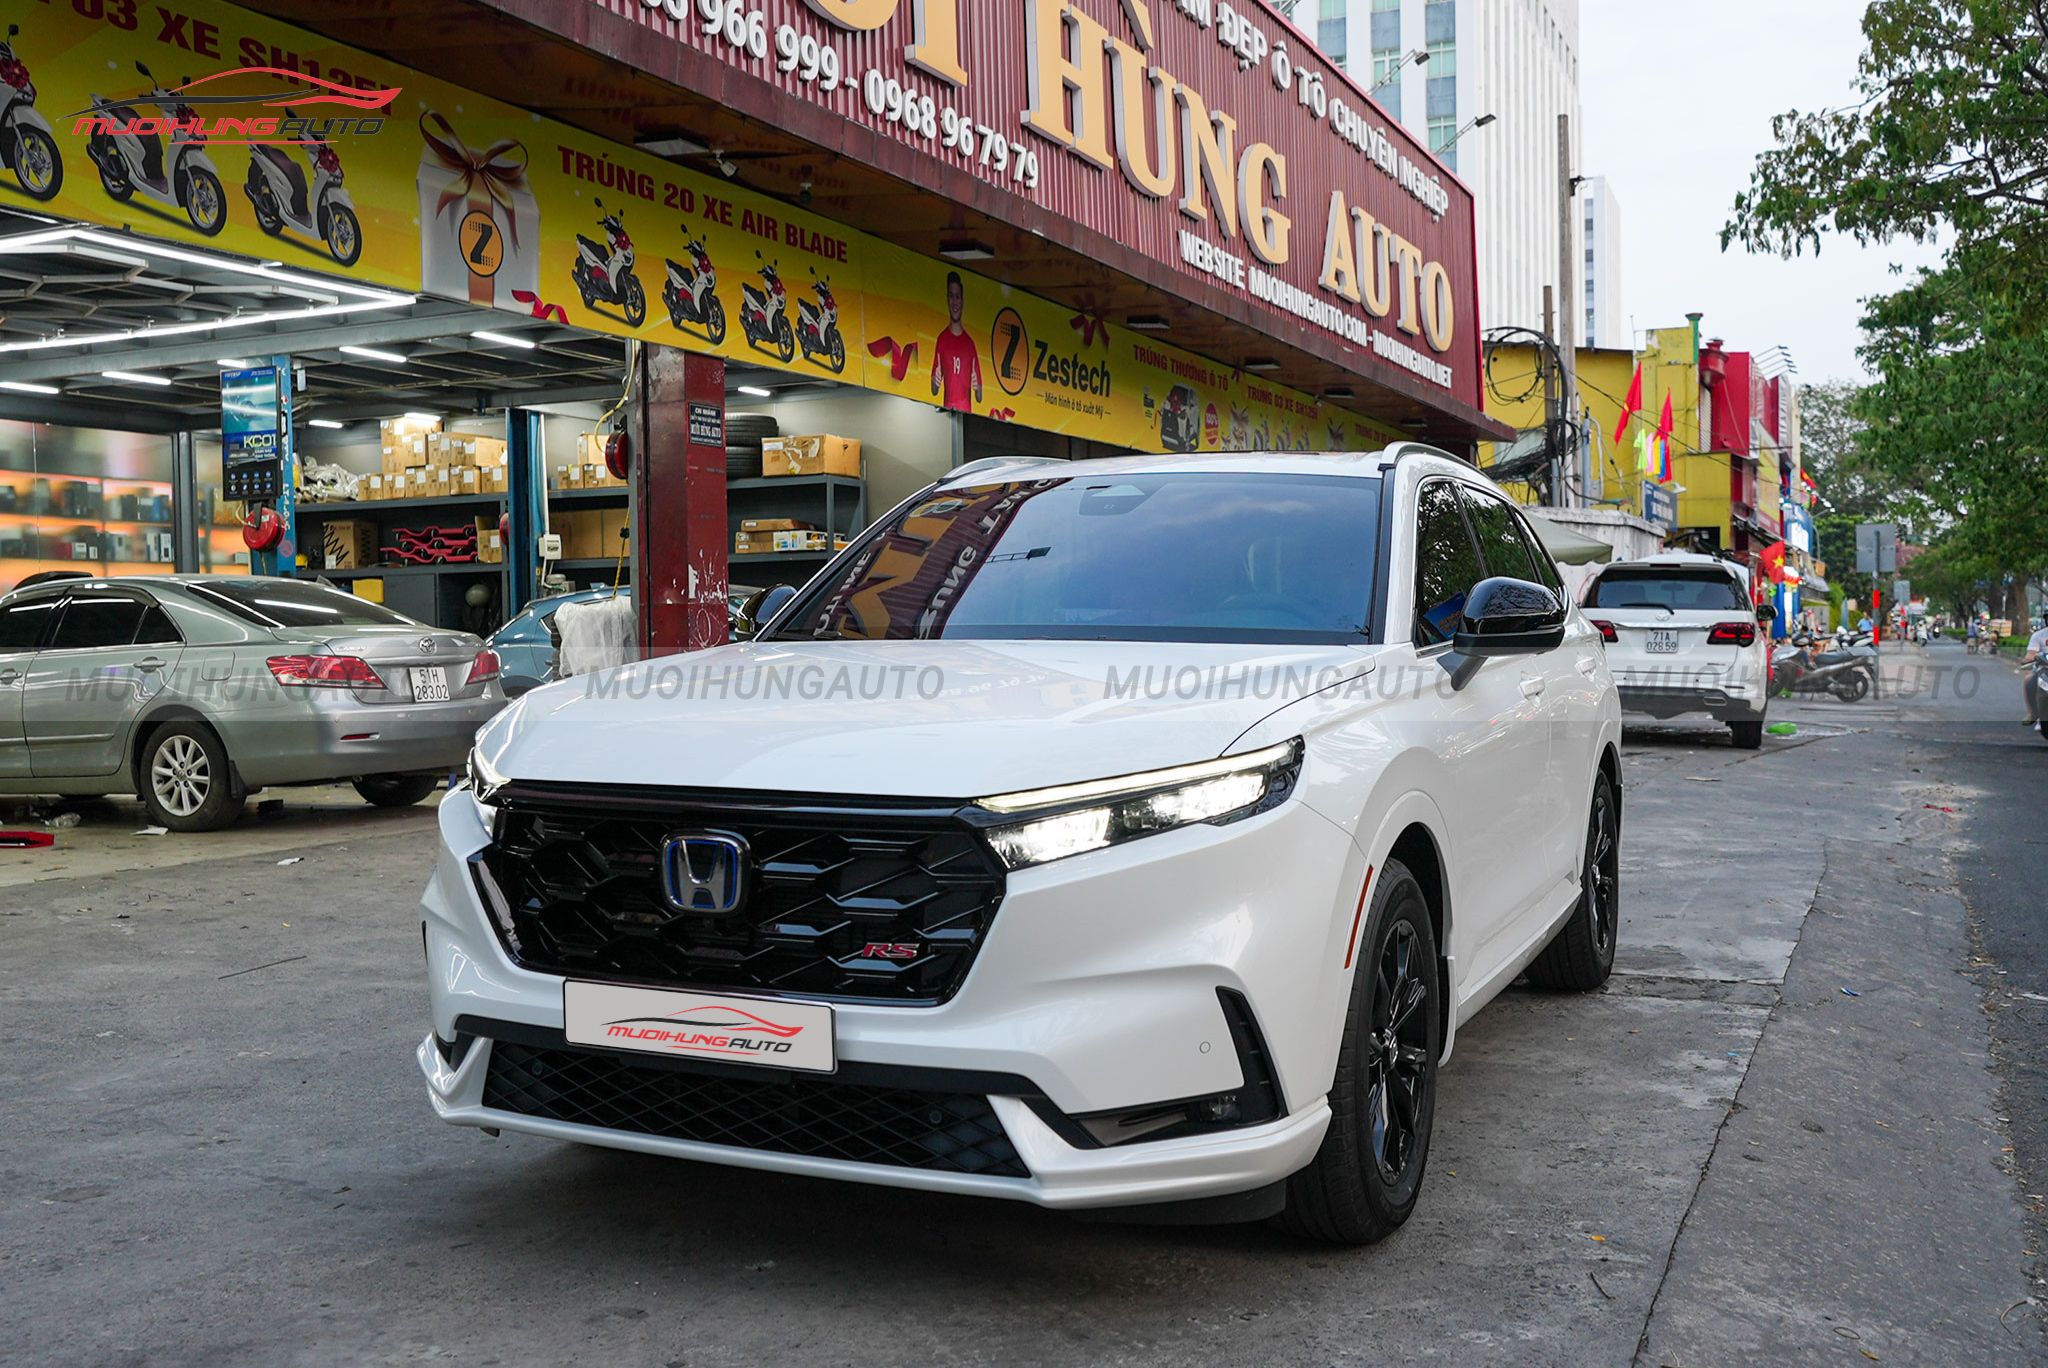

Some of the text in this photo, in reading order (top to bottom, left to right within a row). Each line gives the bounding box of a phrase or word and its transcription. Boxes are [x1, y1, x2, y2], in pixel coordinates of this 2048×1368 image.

[157, 6, 220, 60] XE
[699, 0, 768, 59] 966
[774, 24, 839, 92] 999
[864, 68, 937, 140] 0968
[940, 106, 974, 157] 96
[975, 124, 1008, 171] 79
[1010, 142, 1039, 189] 79
[1215, 2, 1268, 71] ĐẸP
[1271, 40, 1291, 91] Ô
[1295, 66, 1326, 119] TÔ
[1329, 97, 1398, 178] CHUYÊN
[1398, 156, 1449, 222] NGHIỆP
[557, 145, 847, 263] TRÚNG 20 XE AIR BLADE
[1180, 229, 1245, 290] WEBSITE
[1318, 190, 1455, 353] AUTO
[953, 356, 961, 374] 19
[1033, 339, 1111, 398] Zestech
[1133, 343, 1168, 372] TRÚNG
[243, 434, 276, 448] KC01
[1654, 631, 1671, 641] 71A
[416, 685, 448, 700] 283.02
[420, 669, 440, 684] 51H
[861, 942, 920, 959] RS
